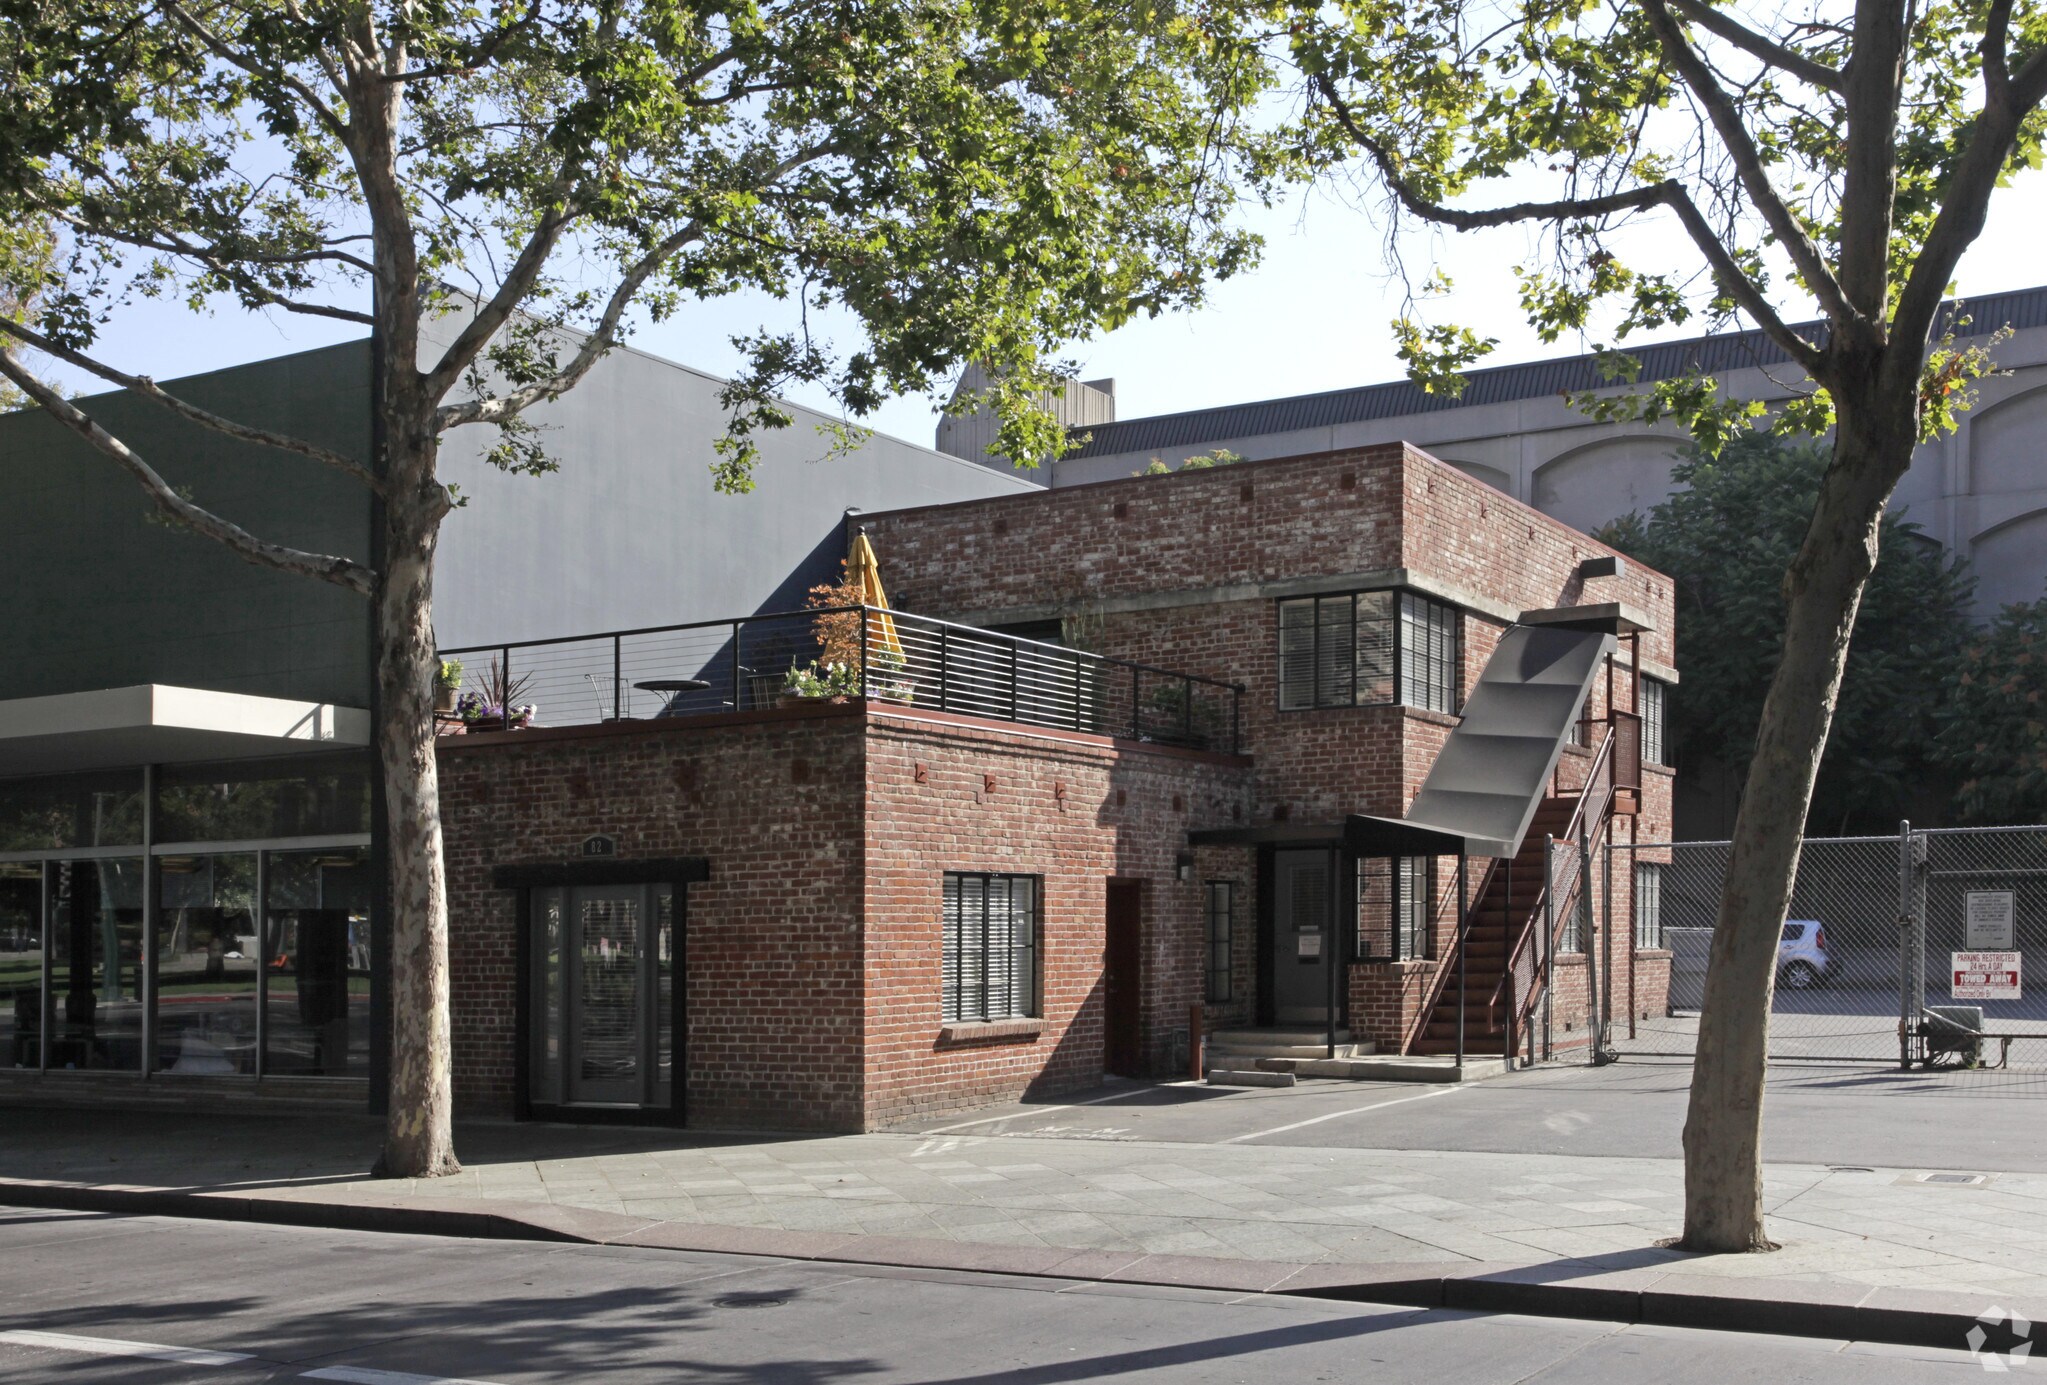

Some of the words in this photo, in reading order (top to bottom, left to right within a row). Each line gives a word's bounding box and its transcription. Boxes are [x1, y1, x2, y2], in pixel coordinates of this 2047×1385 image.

[591, 840, 602, 853] 82
[1957, 953, 1980, 962] PARKING
[1982, 953, 2015, 962] RESTRICTED
[1970, 962, 1977, 970] 24
[1993, 962, 2003, 970] DAY
[1960, 974, 1987, 983] TOWED
[1989, 974, 2012, 983] AWAY
